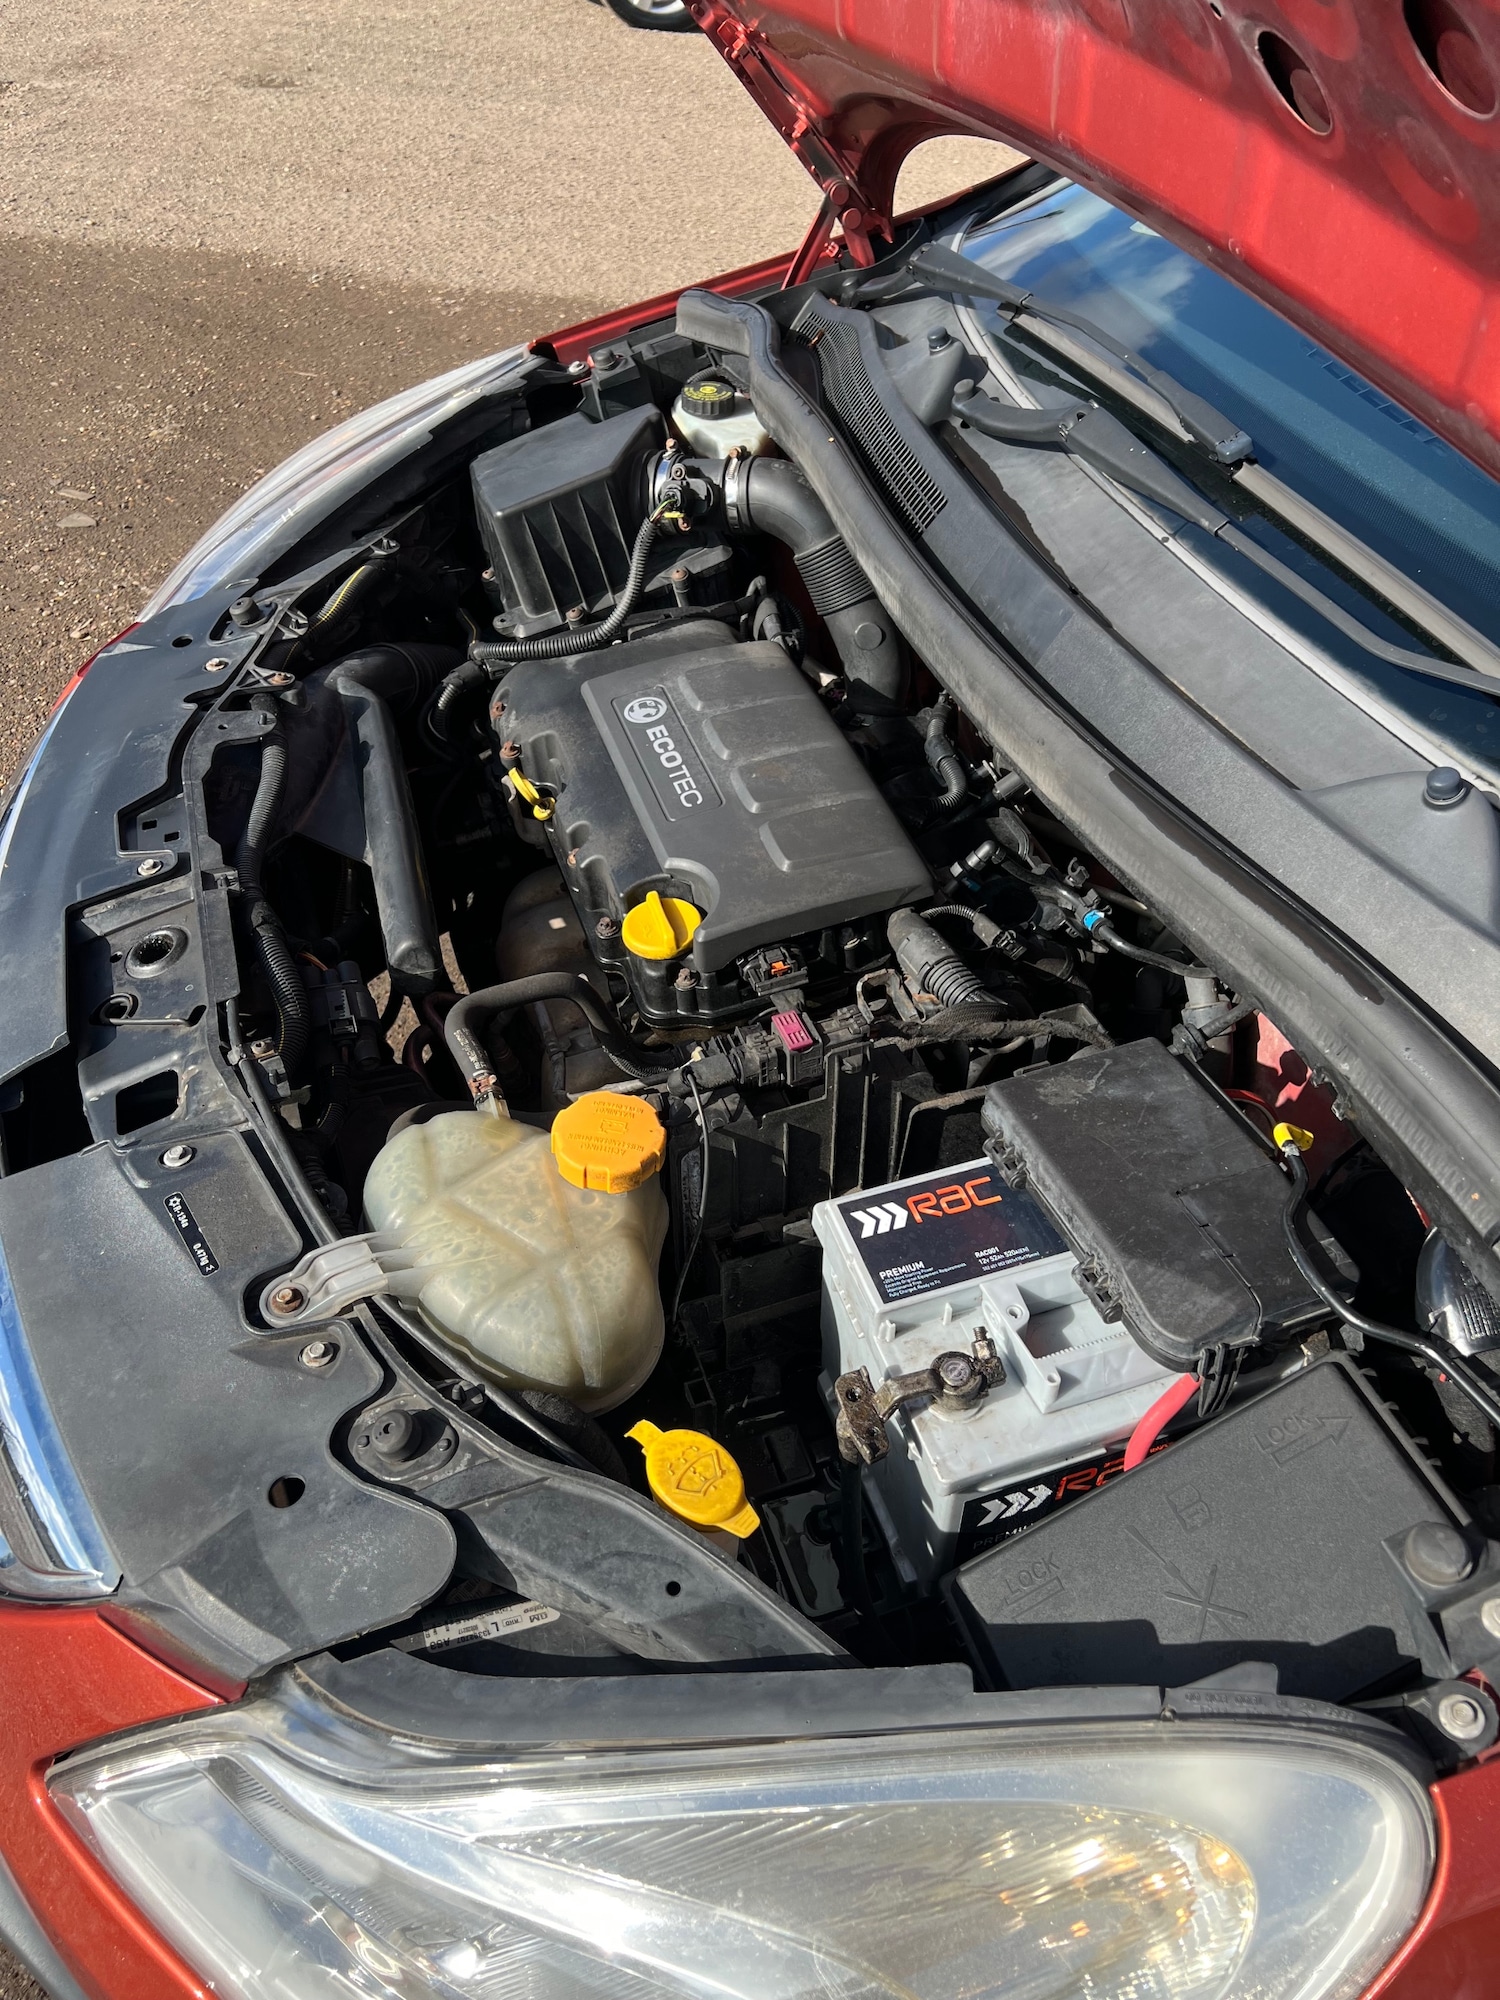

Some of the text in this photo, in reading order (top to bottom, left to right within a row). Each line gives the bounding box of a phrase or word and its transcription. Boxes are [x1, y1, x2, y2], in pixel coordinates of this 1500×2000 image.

[645, 724, 703, 808] ECOTEC
[172, 1204, 189, 1229] R-134a
[879, 1260, 925, 1280] PREMIUM
[1252, 1412, 1312, 1452] LOCK
[1004, 1551, 1061, 1596] LOCK
[490, 1621, 499, 1632] L
